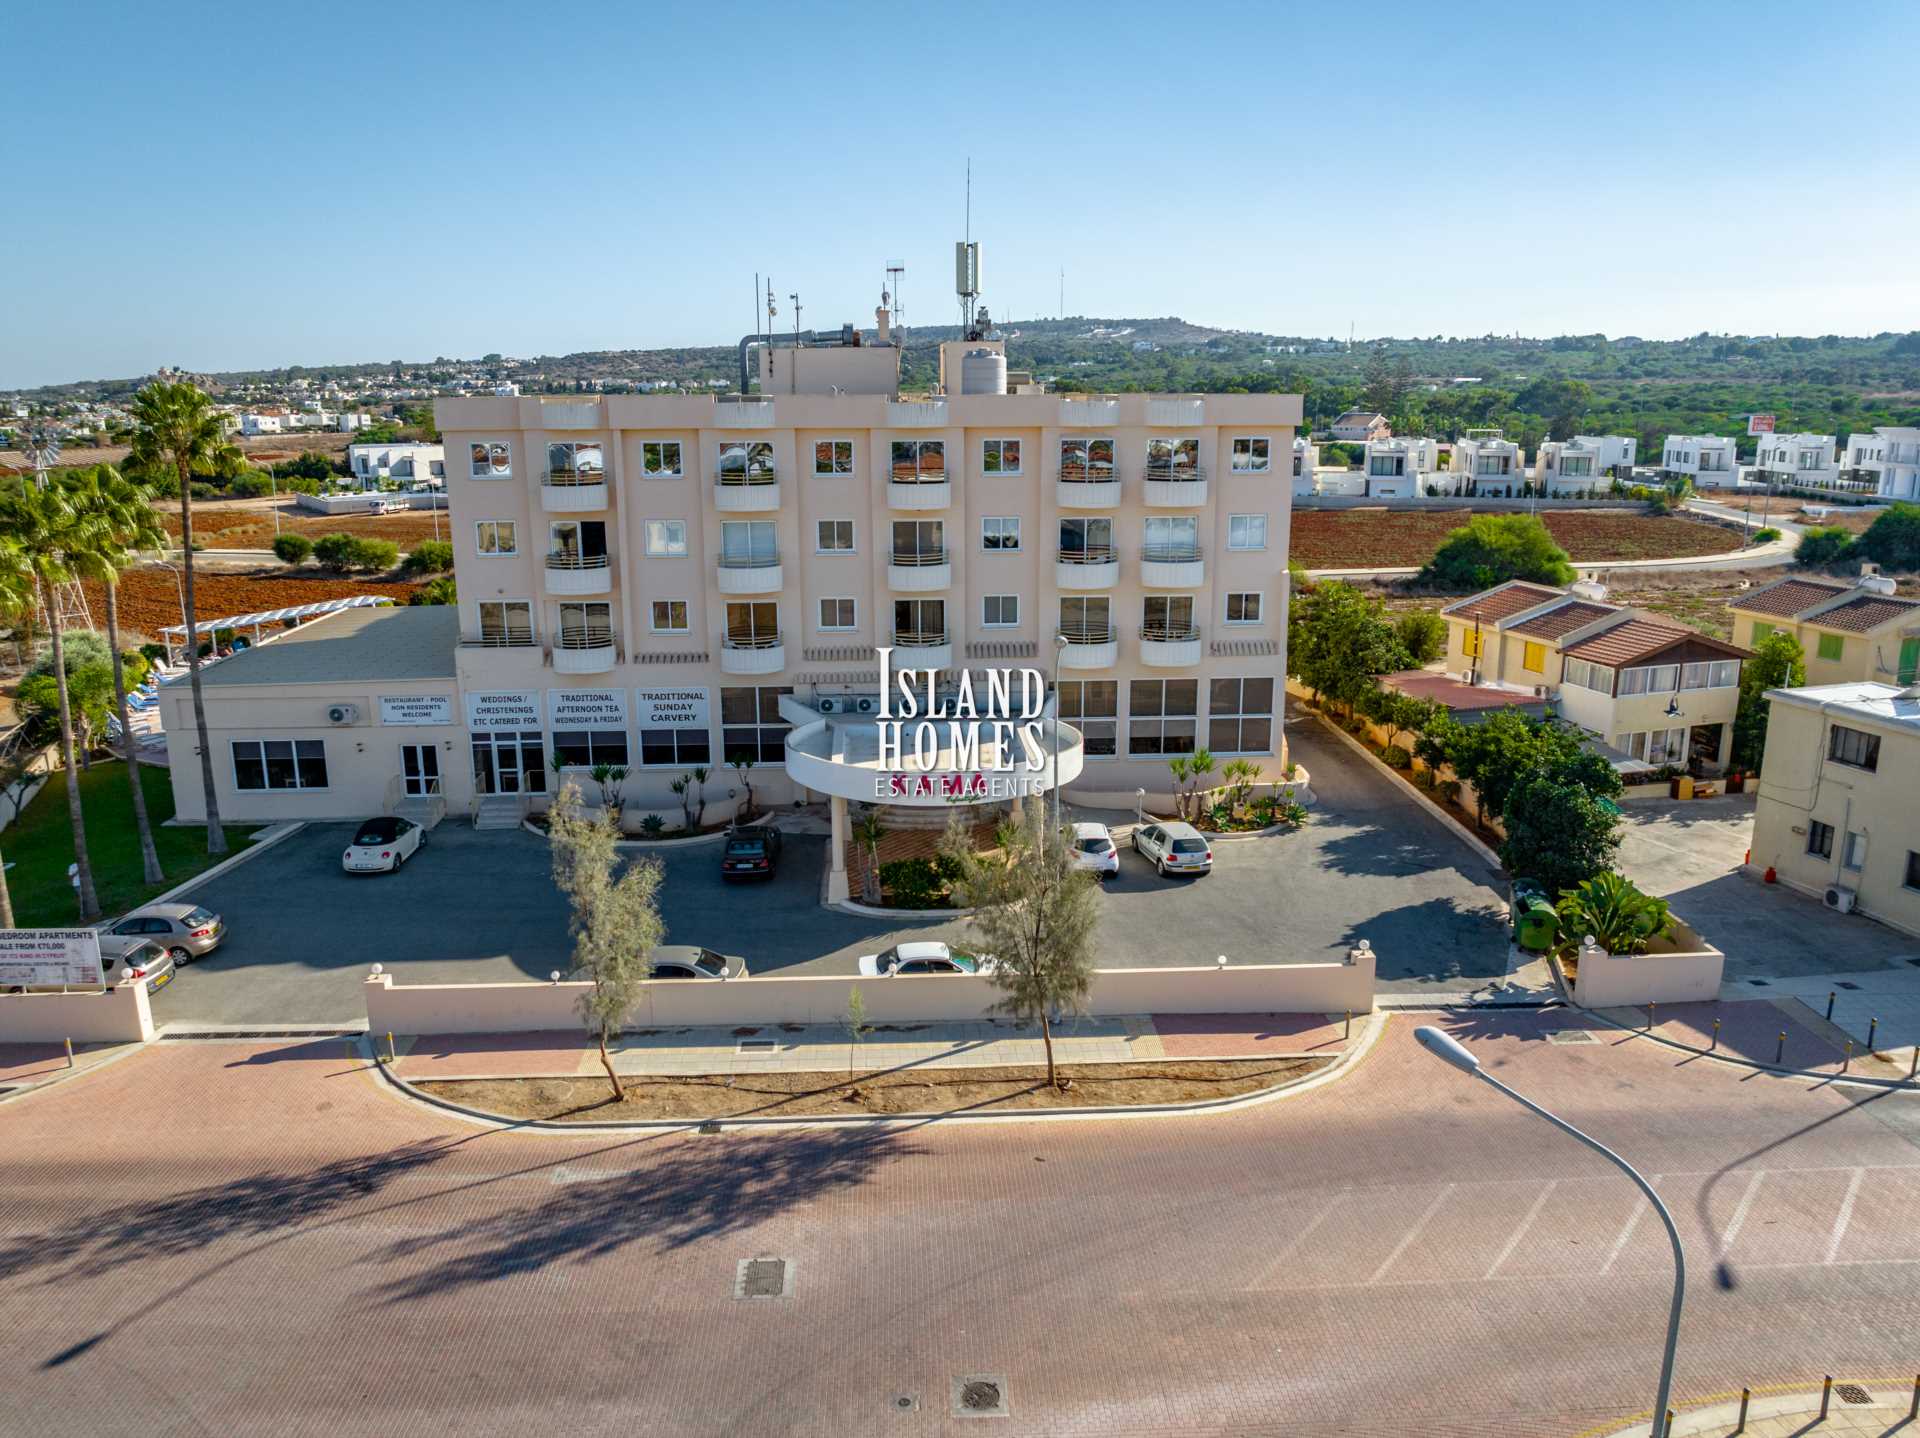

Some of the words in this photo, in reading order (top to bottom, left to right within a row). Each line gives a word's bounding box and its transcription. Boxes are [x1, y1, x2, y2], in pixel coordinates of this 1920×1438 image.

[480, 695, 523, 703] WEDDINGS
[560, 694, 614, 702] TRADITIONAL
[640, 692, 705, 701] TRADITIONAL
[476, 706, 535, 714] CHRISTENINGS
[557, 705, 603, 713] AFTERNOON
[653, 703, 693, 711] SUNDAY
[489, 717, 521, 725] CATERED
[650, 713, 697, 722] CARVERY
[38, 931, 94, 940] APARTMENTS
[0, 942, 14, 950] ALE
[15, 942, 36, 950] FROM
